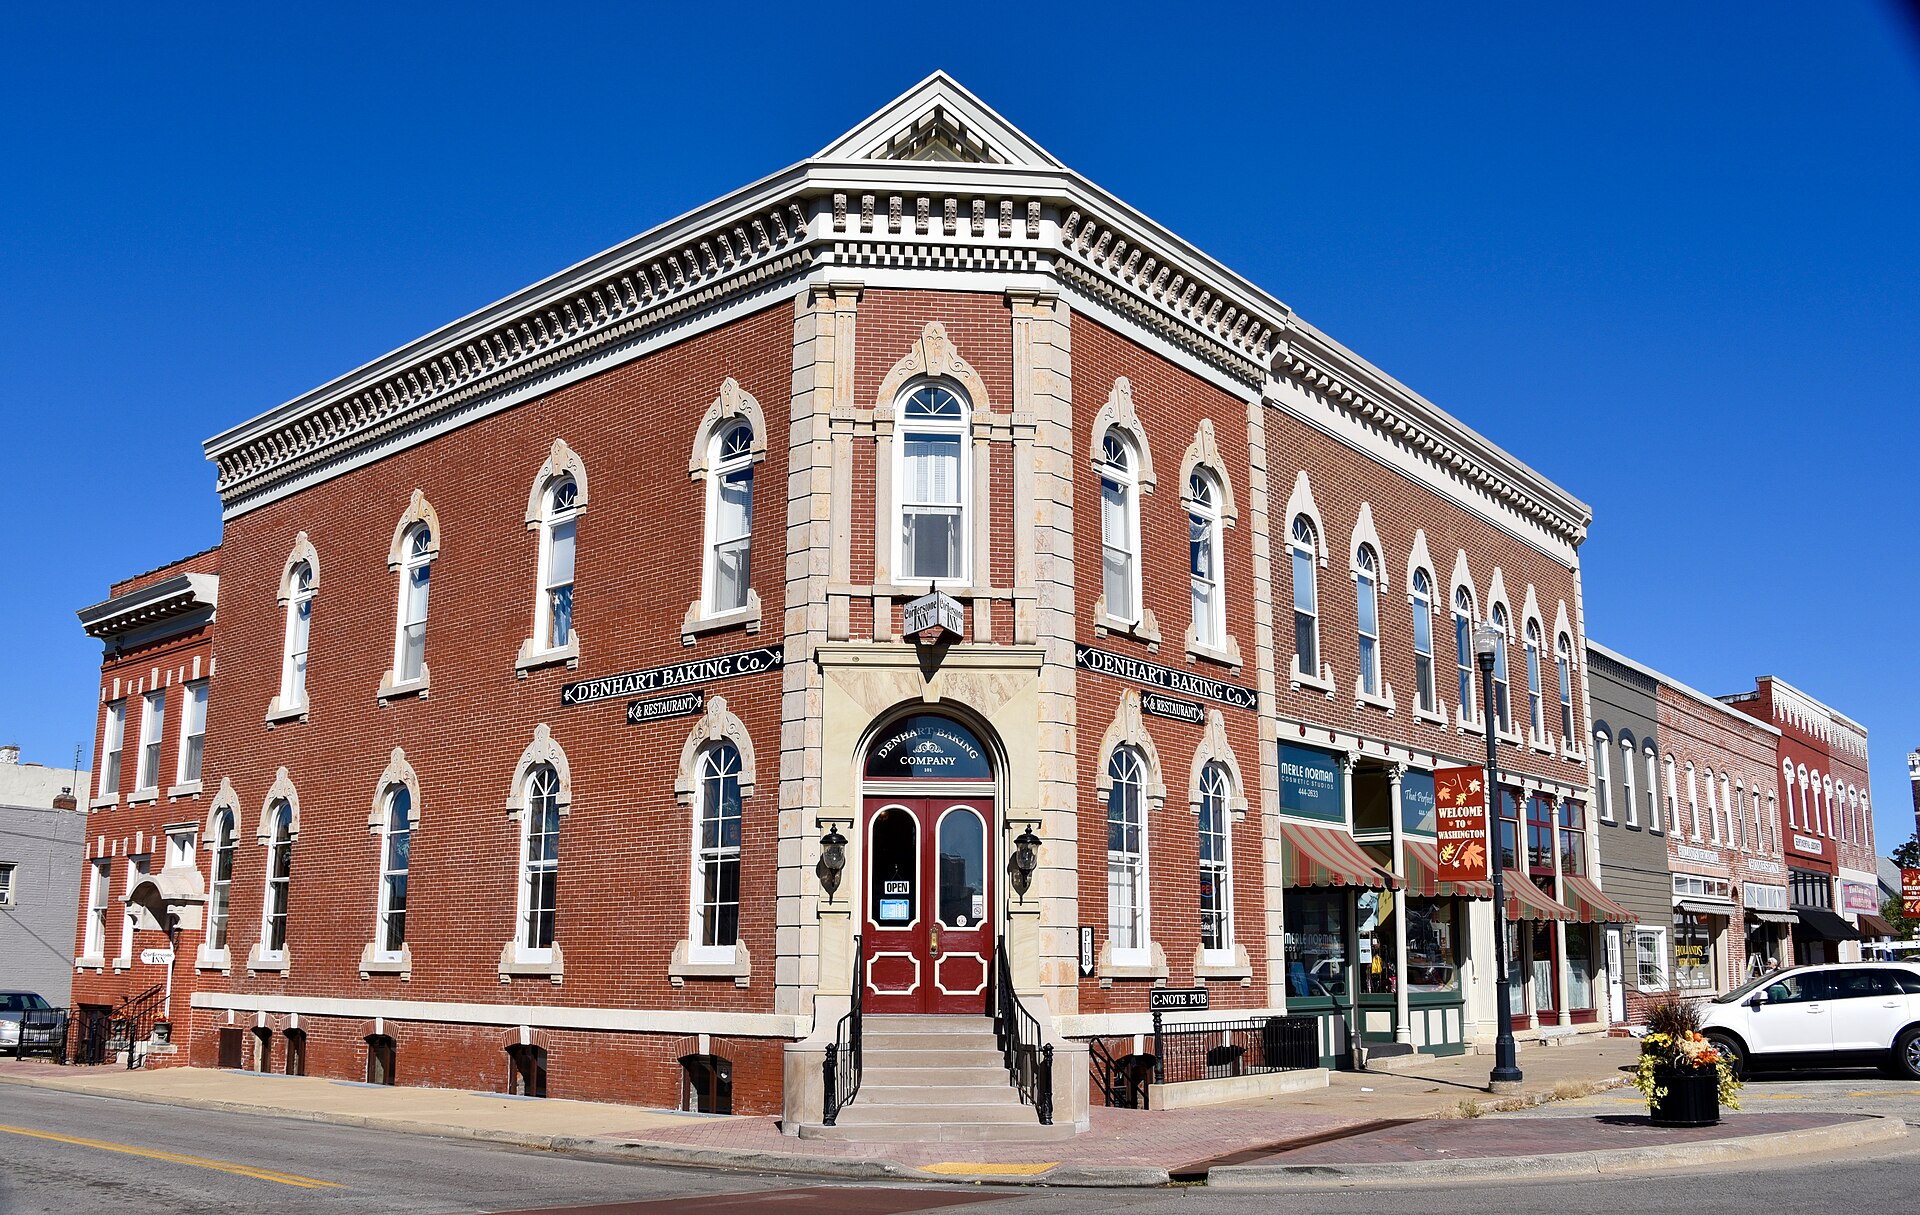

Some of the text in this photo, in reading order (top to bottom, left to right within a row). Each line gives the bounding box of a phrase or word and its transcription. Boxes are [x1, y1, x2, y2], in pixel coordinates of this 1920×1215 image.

[913, 611, 929, 631] INN
[947, 612, 958, 632] INN
[577, 654, 765, 701] DENHART BAKING Co.
[1091, 651, 1246, 705] DENHART BAKING Co.
[635, 697, 694, 718] & RESTAURANT
[1149, 697, 1199, 719] & RESTAURANT
[878, 727, 979, 760] DENHART BAKING
[900, 756, 956, 766] COMPANY
[1281, 762, 1334, 783] MERLE NORMAN
[1281, 775, 1334, 790] COSMETIC STUDIOS
[1404, 788, 1433, 806] That Perfect
[1438, 805, 1483, 818] WELCOME
[1455, 819, 1466, 828] TO
[1438, 829, 1485, 840] WASHINGTON
[886, 882, 908, 893] OPEN
[1285, 932, 1307, 945] MERLE
[1152, 993, 1207, 1005] C-NOTE PUB
